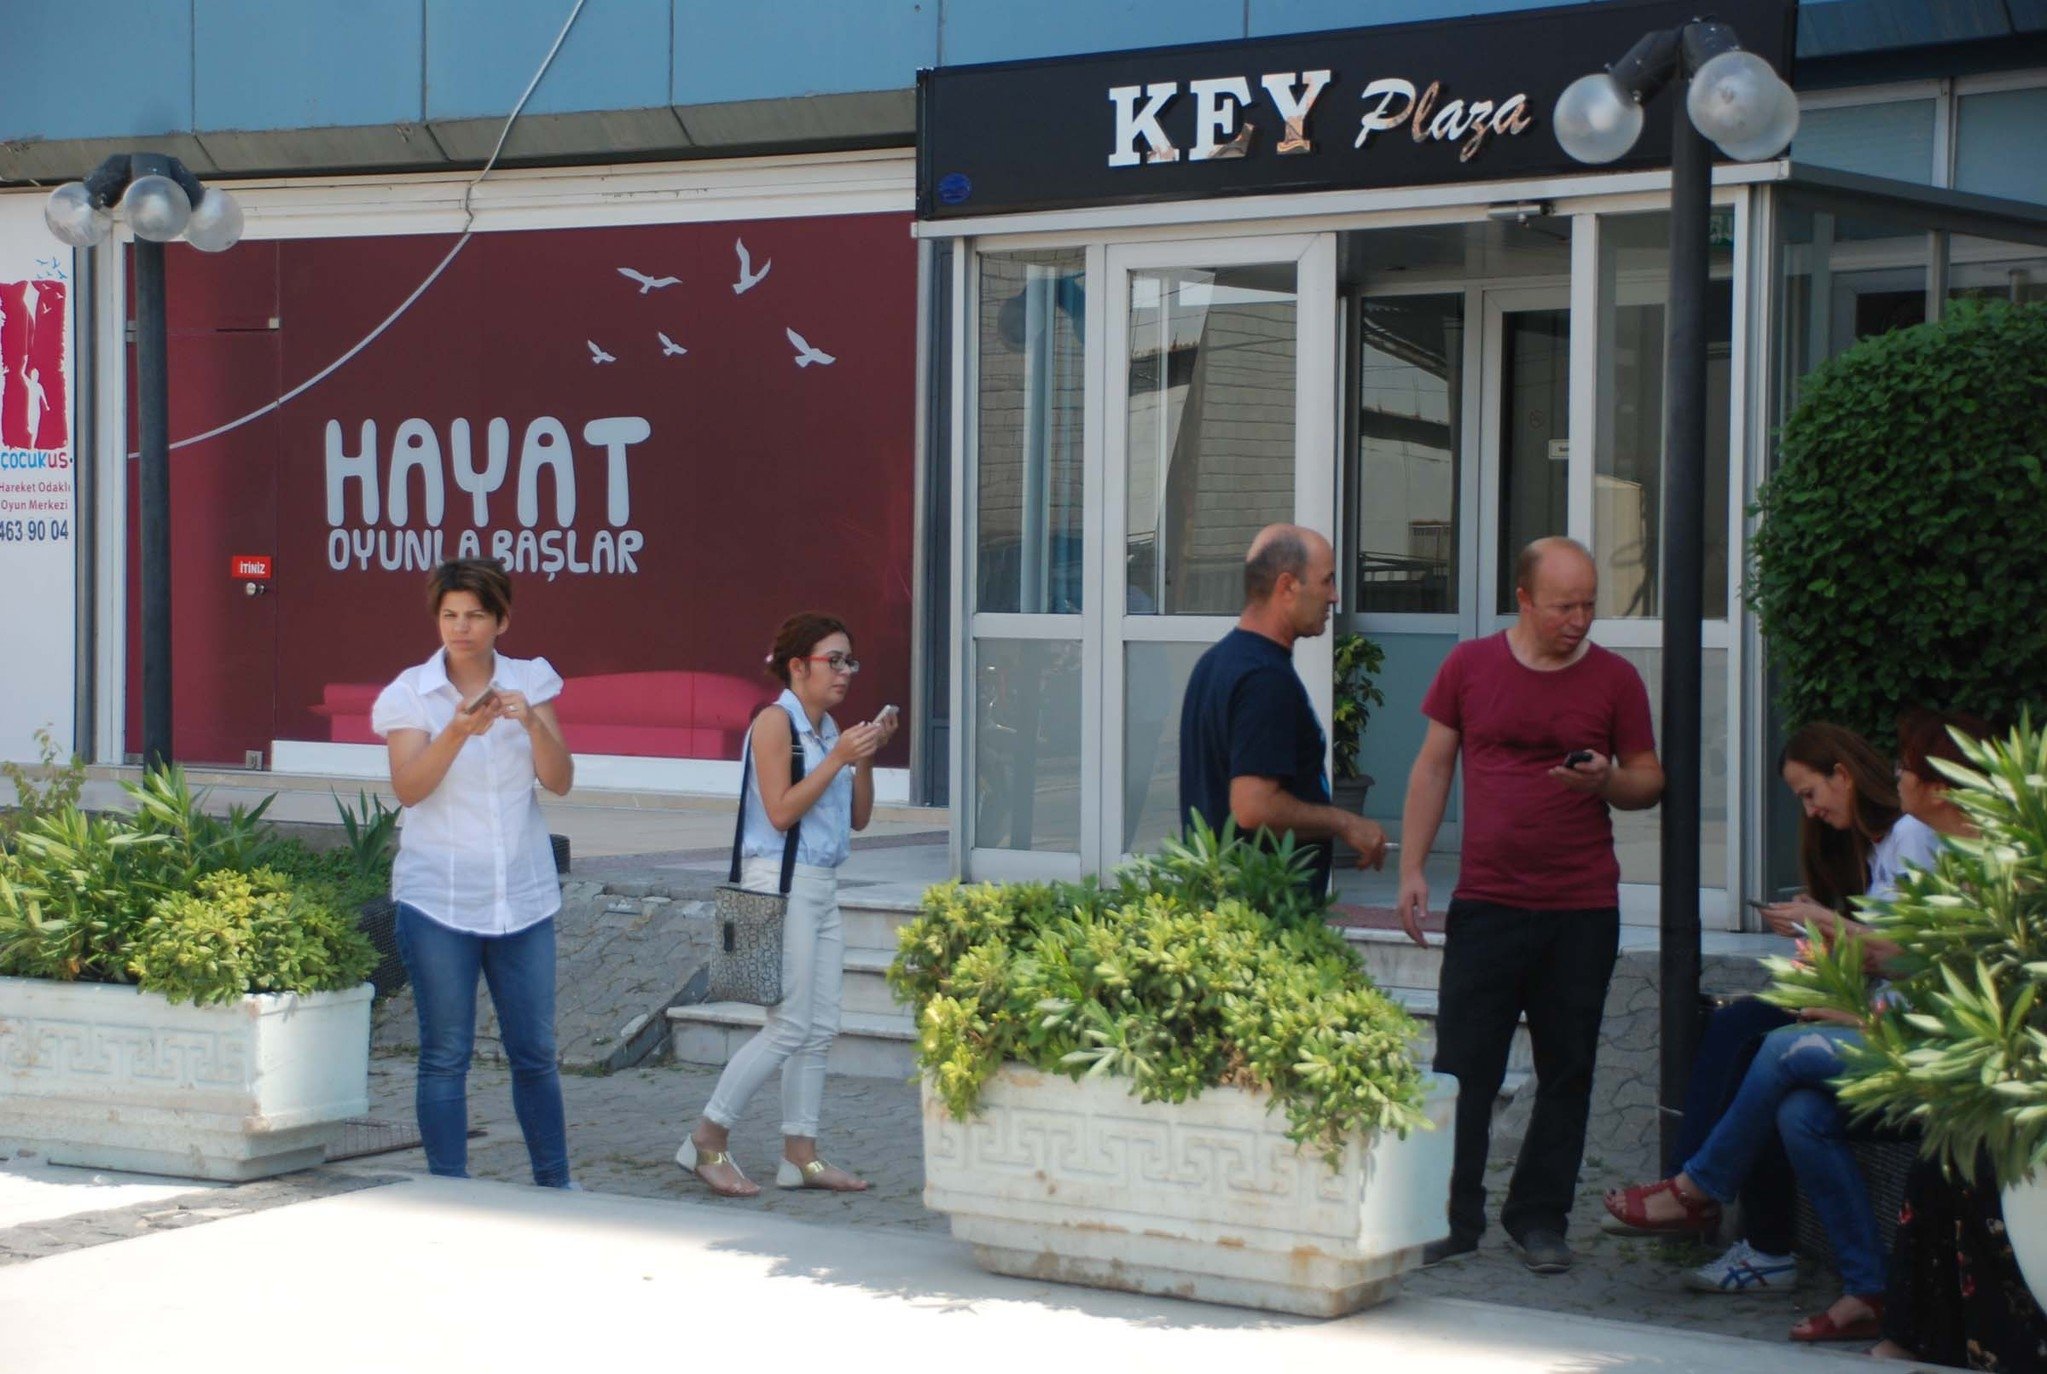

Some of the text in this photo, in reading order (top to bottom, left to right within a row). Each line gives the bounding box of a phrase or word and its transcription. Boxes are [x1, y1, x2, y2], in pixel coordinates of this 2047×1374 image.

[1108, 69, 1532, 167] KEY Plaza
[38, 481, 71, 493] Odaklı
[325, 416, 651, 527] HAYAT
[1, 498, 68, 512] Oyun Merkezi
[0, 519, 69, 541] 463 90 04
[328, 529, 644, 582] OYUNLA BAŞLAR
